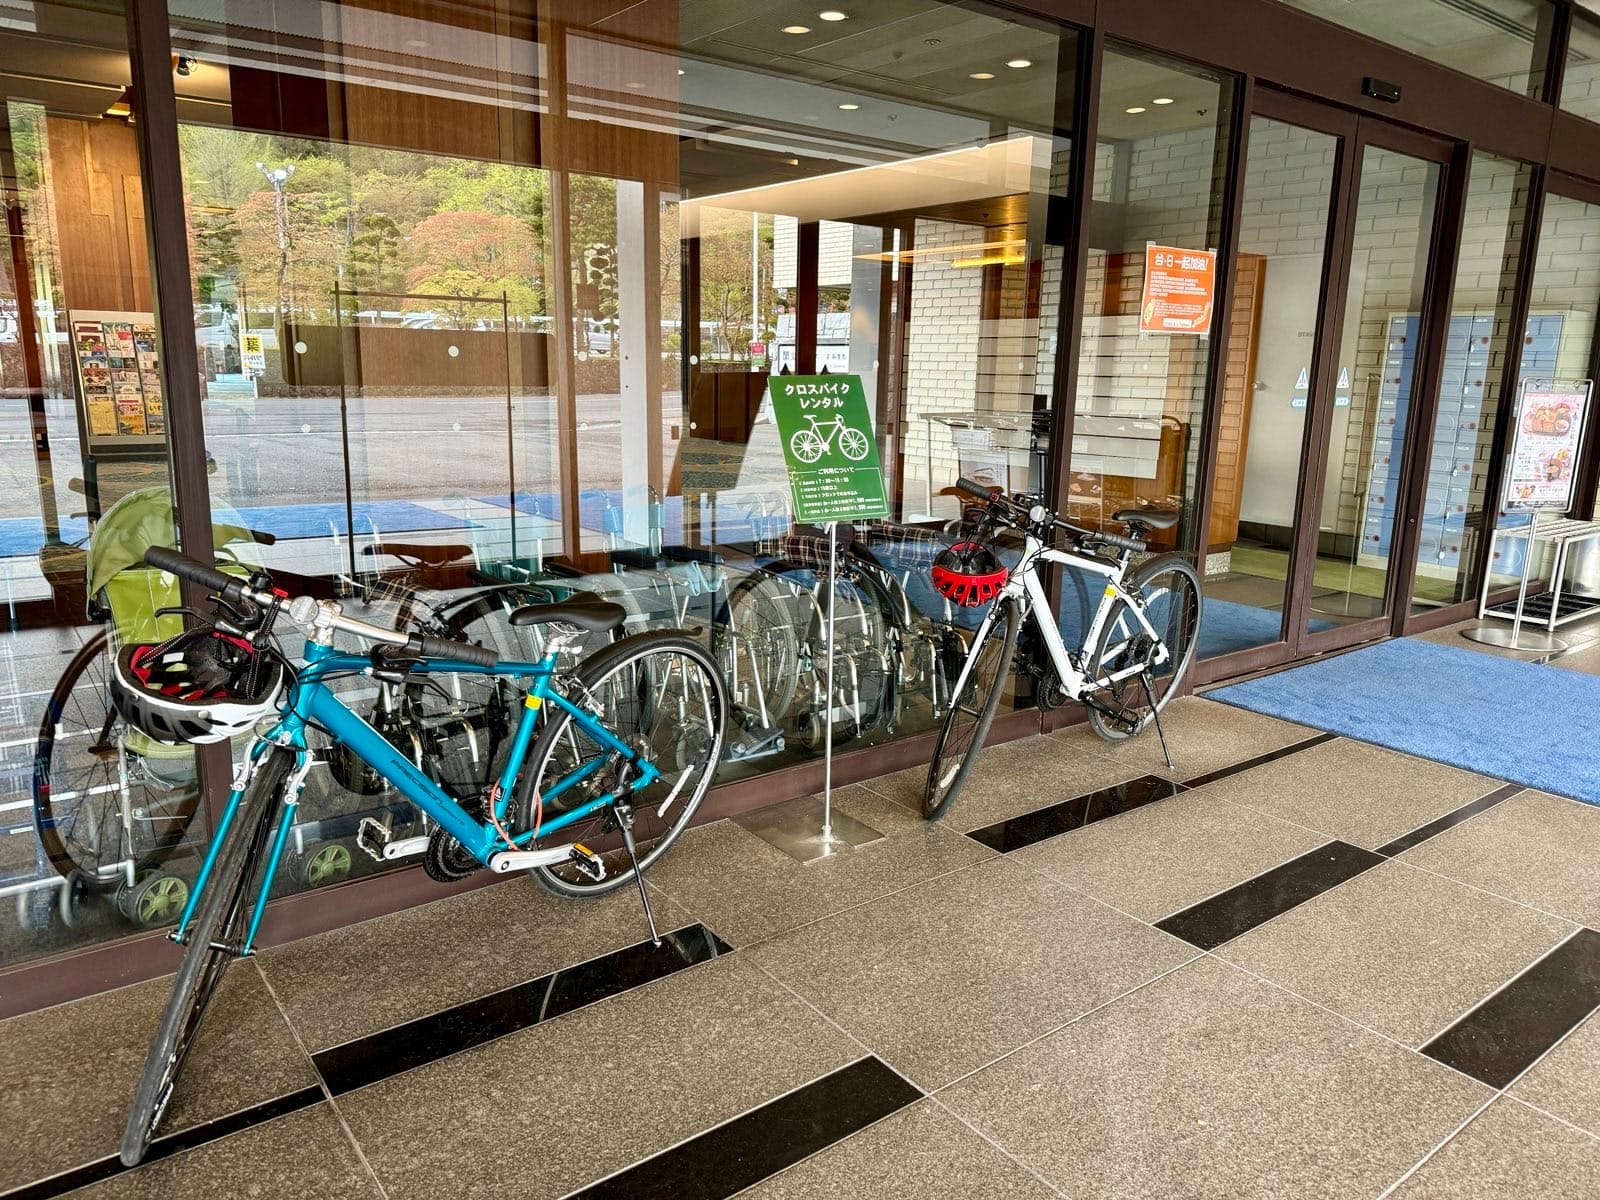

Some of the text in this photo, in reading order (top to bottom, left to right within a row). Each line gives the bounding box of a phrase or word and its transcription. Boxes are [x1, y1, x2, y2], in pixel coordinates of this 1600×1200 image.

[784, 383, 850, 396] クロスバイク
[800, 397, 844, 409] レンタル
[817, 467, 855, 475] ご利用について
